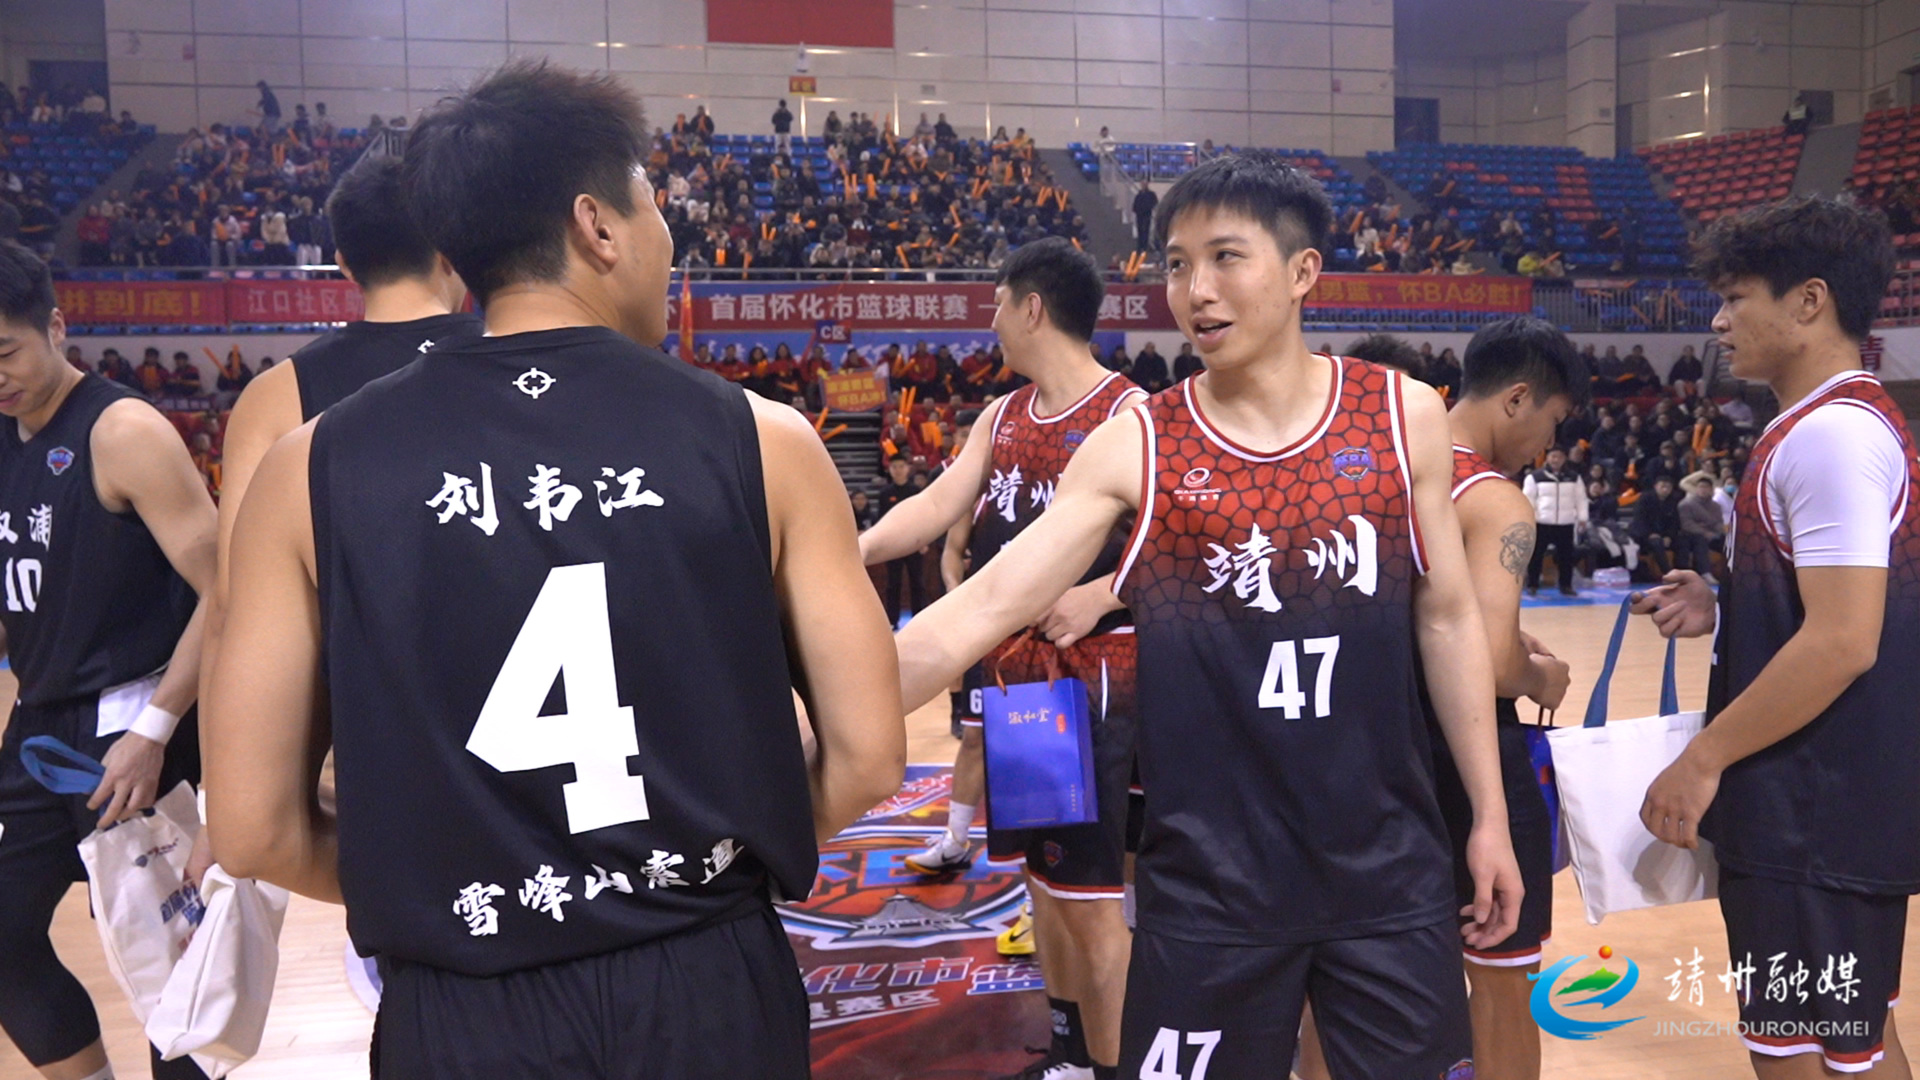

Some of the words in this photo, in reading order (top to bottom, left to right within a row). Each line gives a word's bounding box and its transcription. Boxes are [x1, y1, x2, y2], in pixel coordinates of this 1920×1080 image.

[709, 293, 968, 322] 首届怀化市篮球联赛
[820, 325, 847, 341] C区
[425, 461, 664, 536] 刘韦江
[5, 556, 43, 613] 10
[1202, 514, 1378, 613] 靖州
[465, 561, 650, 835] 4
[1258, 635, 1340, 720] 47
[799, 956, 1046, 996] 化市篮
[1139, 1026, 1222, 1080] 47
